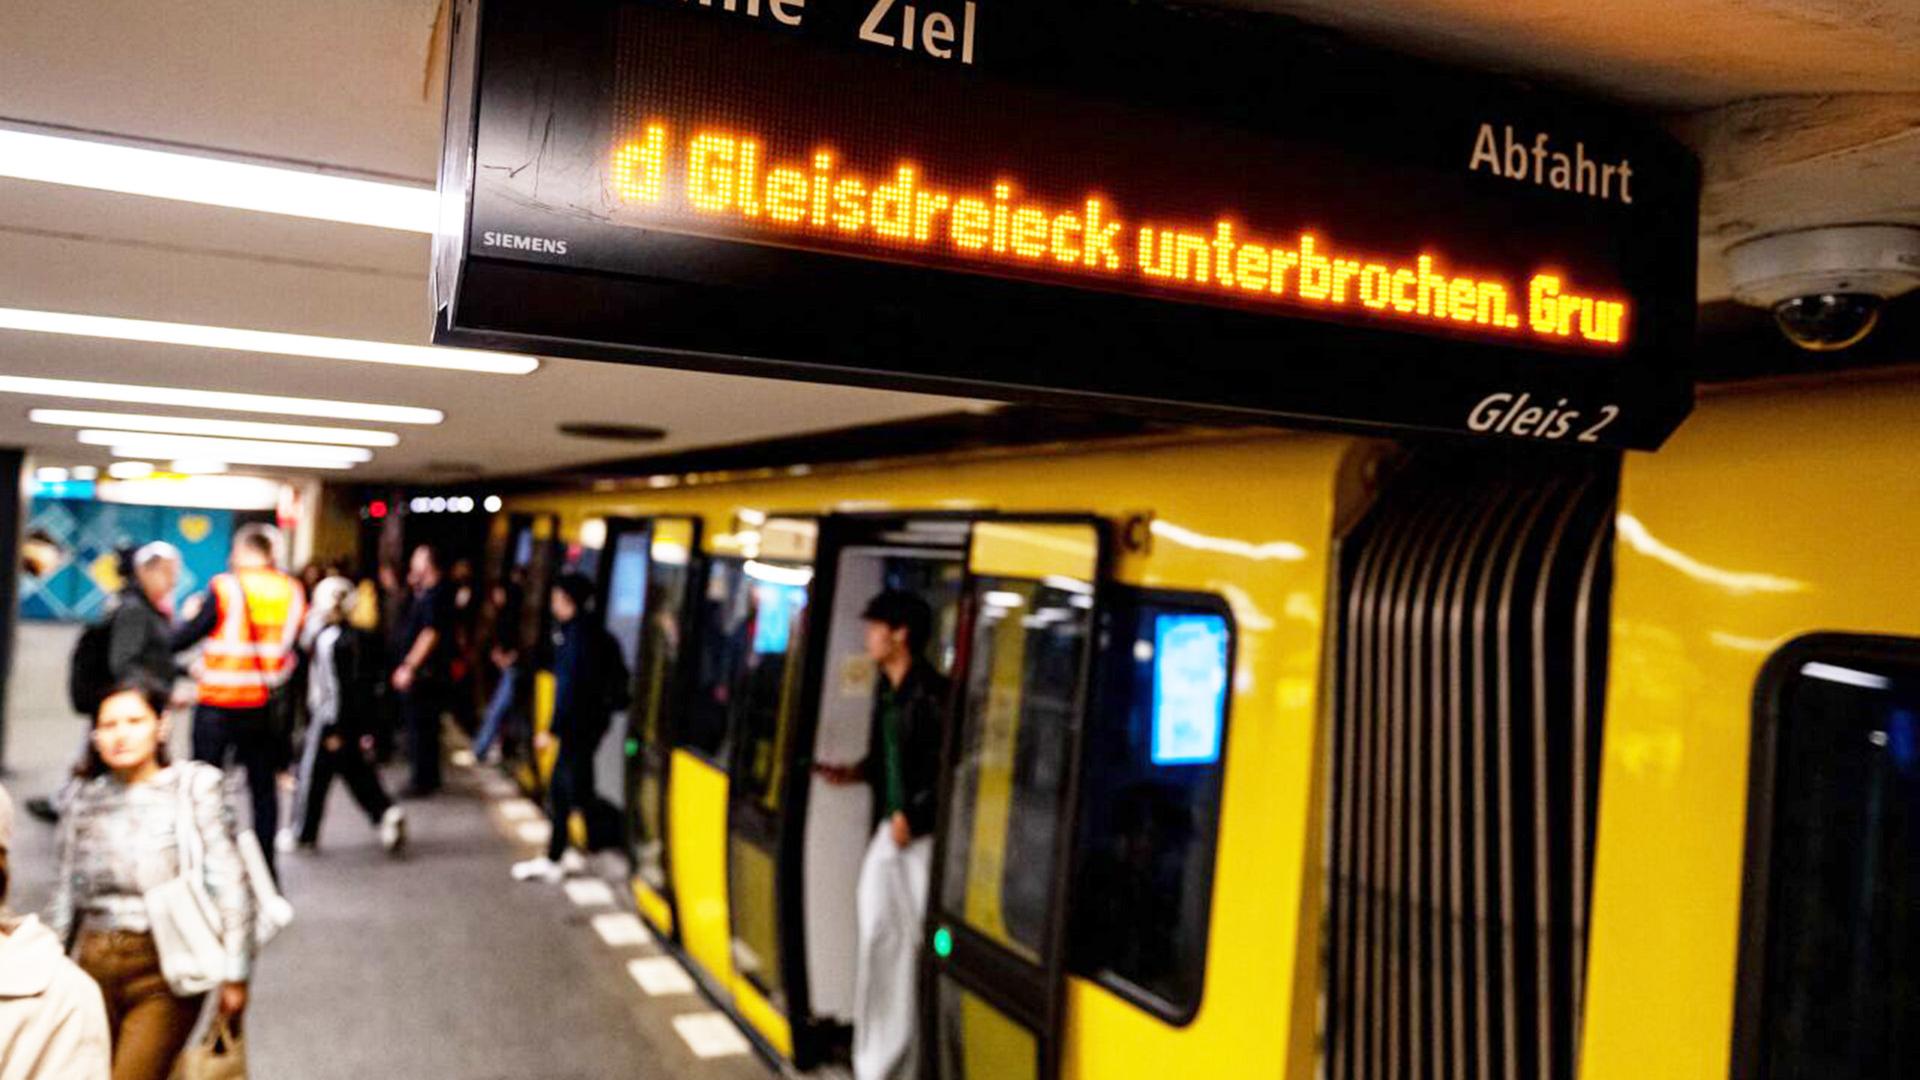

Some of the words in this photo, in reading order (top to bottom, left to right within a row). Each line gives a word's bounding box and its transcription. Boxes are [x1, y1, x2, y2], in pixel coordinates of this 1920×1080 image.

[859, 0, 976, 64] Ziel
[1469, 123, 1632, 203] Abfahrt
[483, 231, 567, 255] SIEMENS
[687, 132, 1121, 269] Gleisdreieck
[1138, 221, 1519, 329] unterbrochen.
[1467, 393, 1578, 440] Gleis
[1578, 405, 1619, 443] 2
